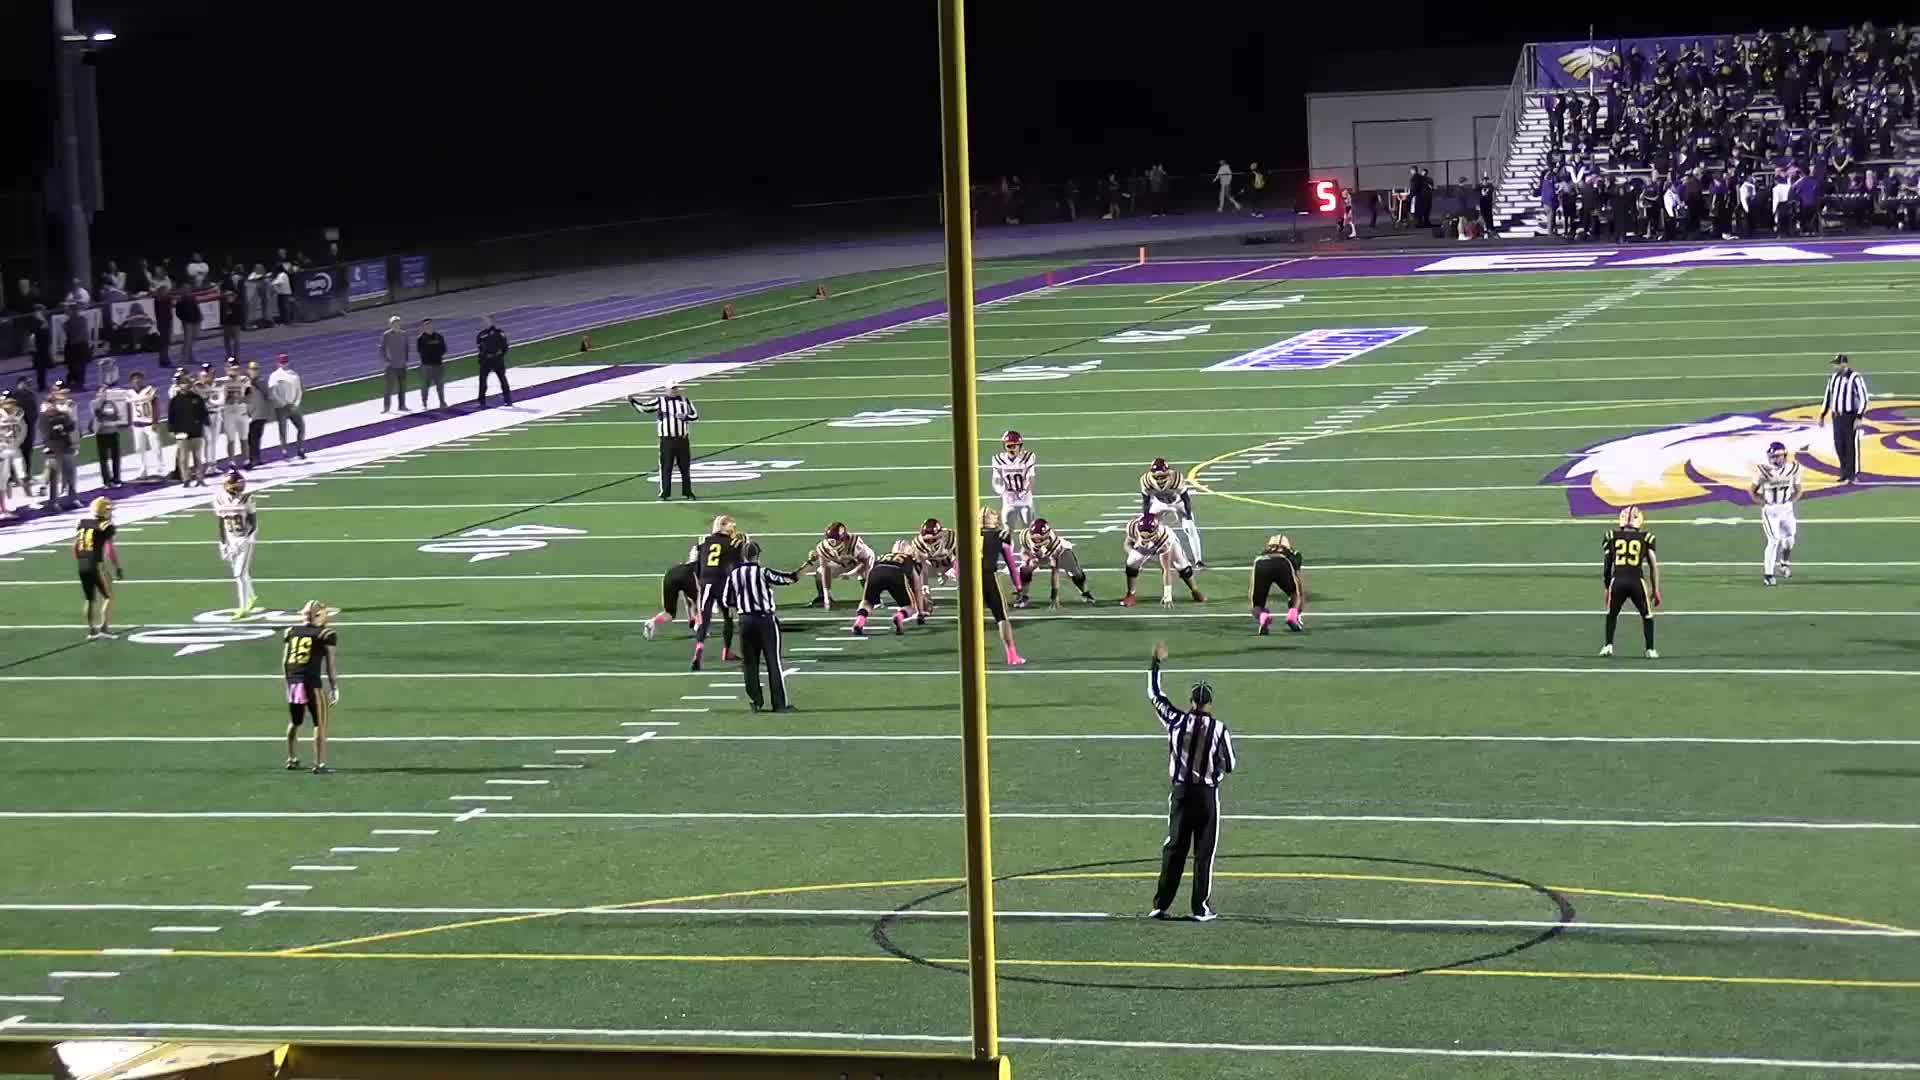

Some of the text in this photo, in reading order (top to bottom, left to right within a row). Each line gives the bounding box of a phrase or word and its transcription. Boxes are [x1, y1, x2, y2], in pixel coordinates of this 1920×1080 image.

[1006, 473, 1024, 492] 10
[1771, 485, 1790, 504] 17
[707, 543, 722, 567] 2
[1615, 539, 1641, 566] 29
